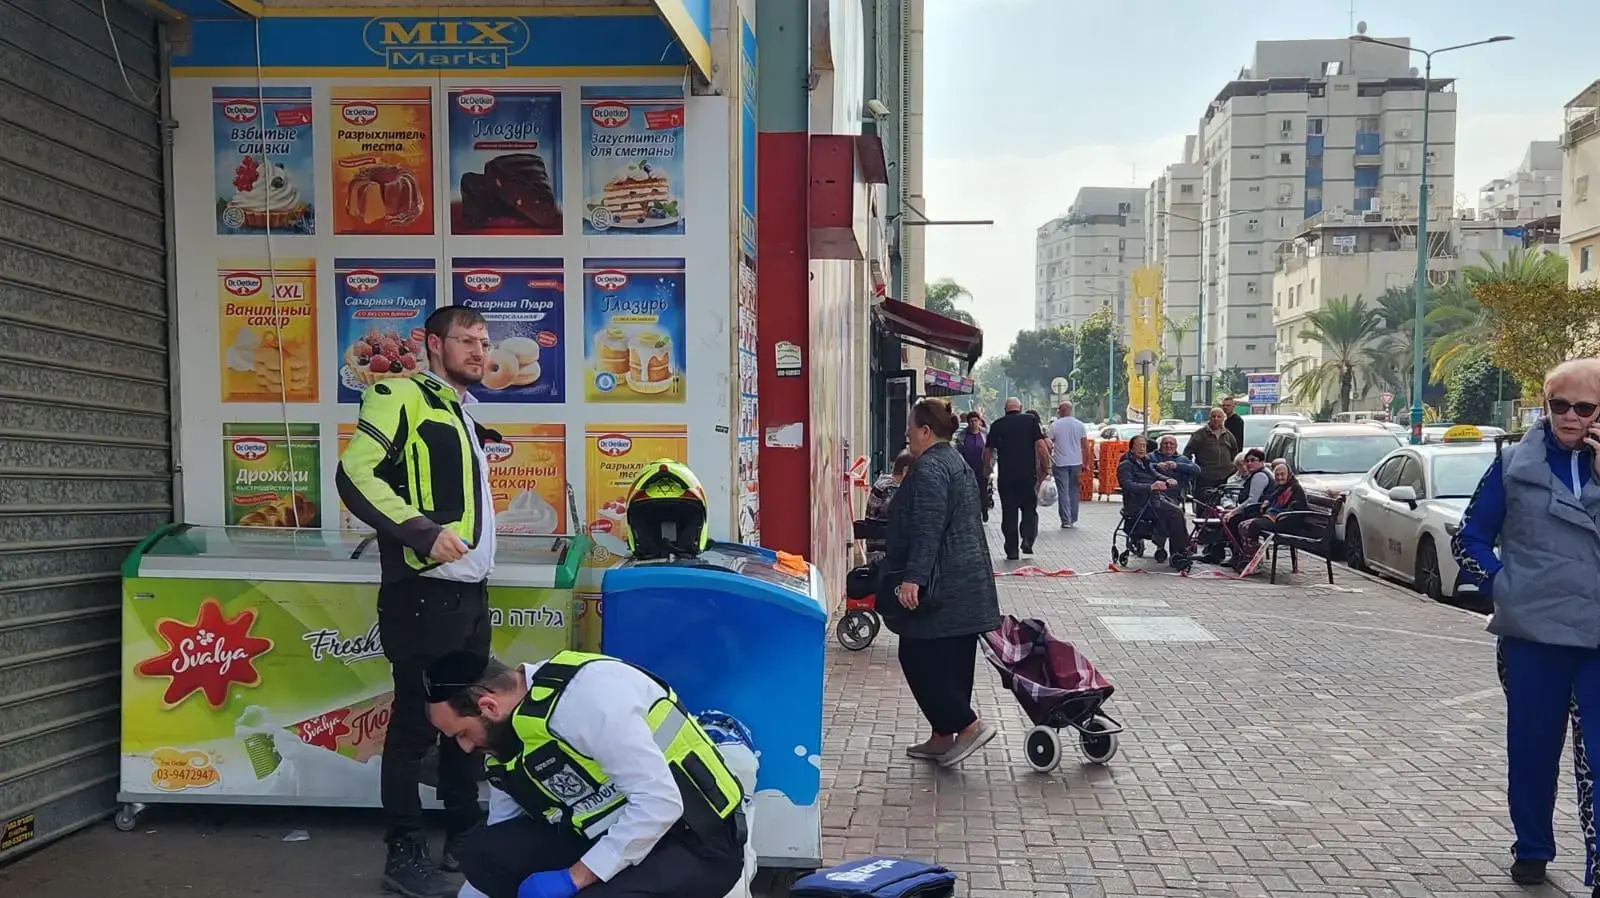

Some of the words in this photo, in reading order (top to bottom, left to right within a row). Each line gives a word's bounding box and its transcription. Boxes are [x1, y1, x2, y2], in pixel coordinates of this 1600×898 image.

[379, 21, 515, 44] MIX
[392, 52, 501, 65] Markt
[230, 127, 298, 140] Взбитые
[472, 118, 542, 140] Глазурь
[338, 130, 427, 143] Разрыхлитель
[592, 133, 676, 147] Загуститель
[238, 142, 290, 154] сливки
[361, 143, 404, 152] теста
[590, 146, 613, 158] для
[615, 147, 674, 157] сметаны
[271, 284, 303, 299] XXL
[345, 296, 394, 308] Сахарная
[396, 296, 427, 308] Пудра
[463, 298, 518, 311] Сахарная
[520, 298, 554, 311] Пудра
[601, 295, 669, 314] Глазурь
[226, 303, 312, 317] Ванильный
[247, 317, 290, 329] сахар
[236, 468, 309, 486] Дрожжи
[489, 465, 557, 477] нильный
[490, 479, 537, 491] сахар
[510, 607, 564, 627] גלידה
[303, 621, 381, 659] Fresh
[171, 637, 249, 675] Svalya
[302, 716, 342, 743] Svalya
[351, 707, 389, 745] Пло
[157, 768, 214, 781] 03-9472947
